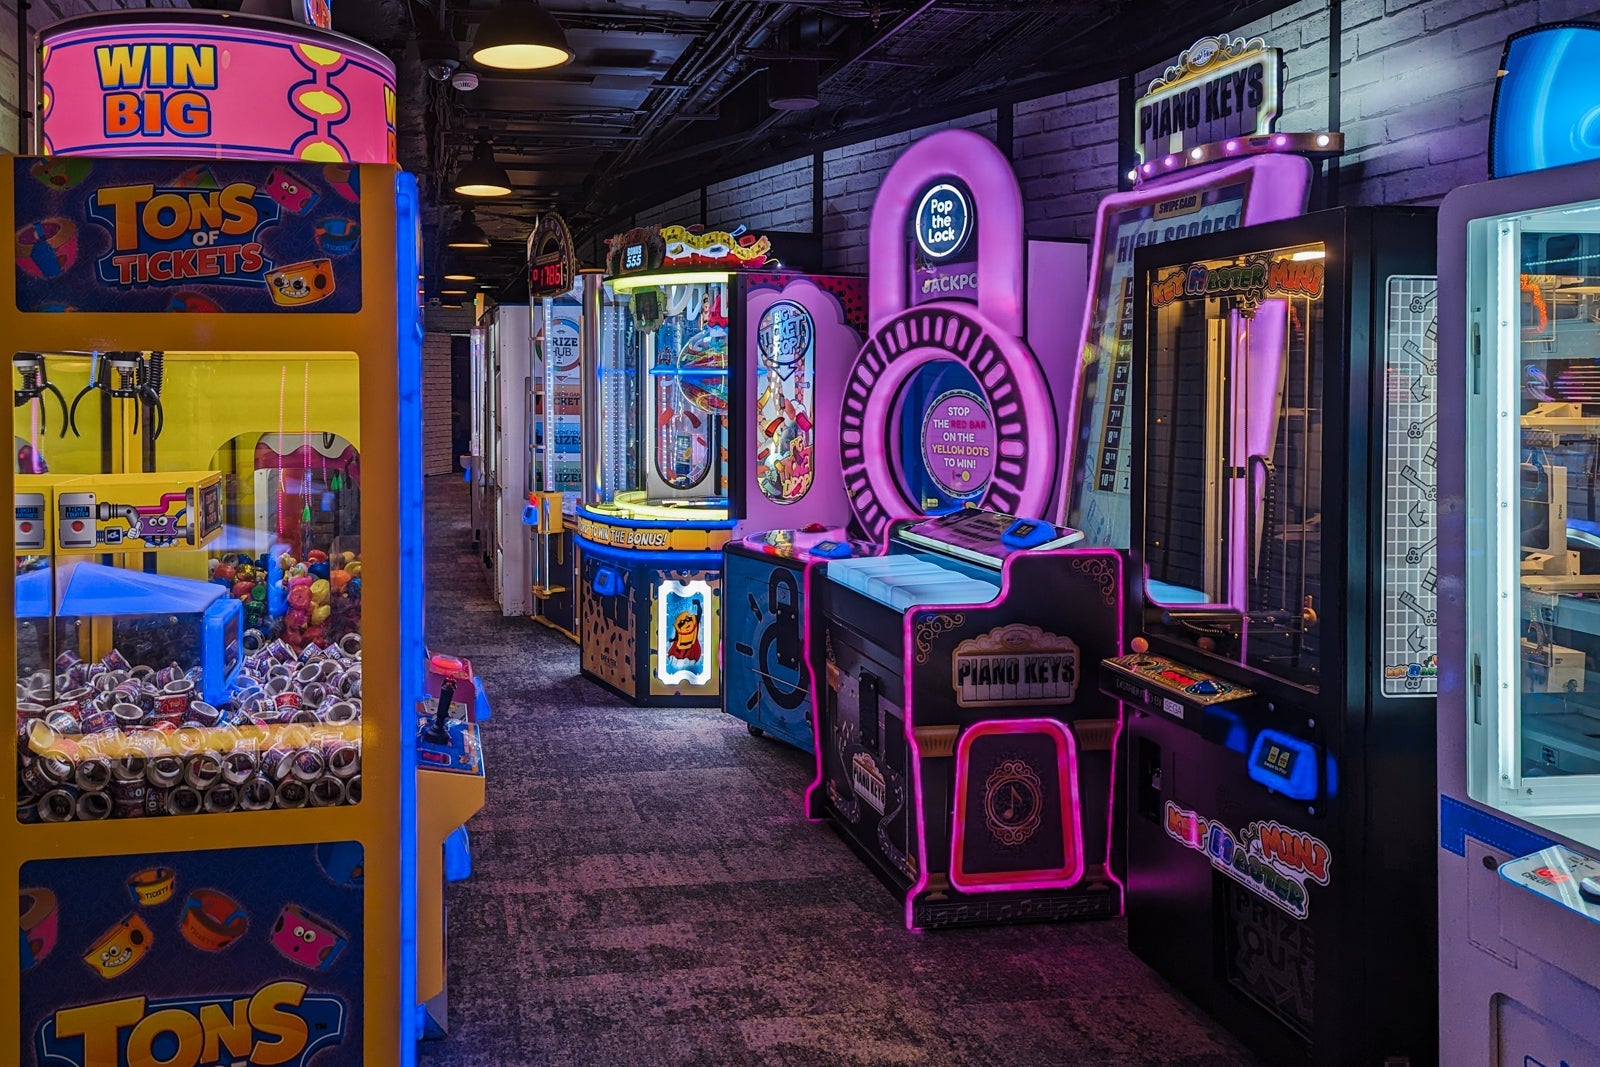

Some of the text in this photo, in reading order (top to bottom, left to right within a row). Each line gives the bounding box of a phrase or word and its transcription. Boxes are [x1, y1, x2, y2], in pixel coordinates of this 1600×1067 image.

[95, 44, 217, 89] WIN
[1140, 62, 1264, 144] PIANO KEYS
[103, 91, 211, 138] BIG
[931, 199, 953, 215] Pop
[1159, 195, 1198, 214] SWIPE CARD
[97, 183, 258, 251] TONS
[931, 214, 952, 228] the
[192, 230, 220, 246] OF
[928, 227, 955, 243] Lock
[112, 243, 263, 285] TICKETS
[626, 254, 643, 269] 555
[922, 272, 979, 294] JACKPO
[1152, 260, 1324, 306] KEY MASTER MINI
[948, 407, 970, 417] STOP
[934, 419, 986, 430] THE RED BAR
[943, 432, 975, 443] ON THE
[932, 444, 989, 457] YELLOW DOTS
[944, 458, 976, 469] TO WIN!
[591, 525, 599, 537] TO
[610, 530, 625, 544] THE
[627, 532, 667, 546] BONUS!
[957, 655, 1075, 686] PIANO KEYS
[1165, 700, 1183, 716] SEGA
[1167, 807, 1304, 912] KEY MASTER
[1261, 826, 1327, 880] MINI
[55, 981, 309, 1067] TONS
